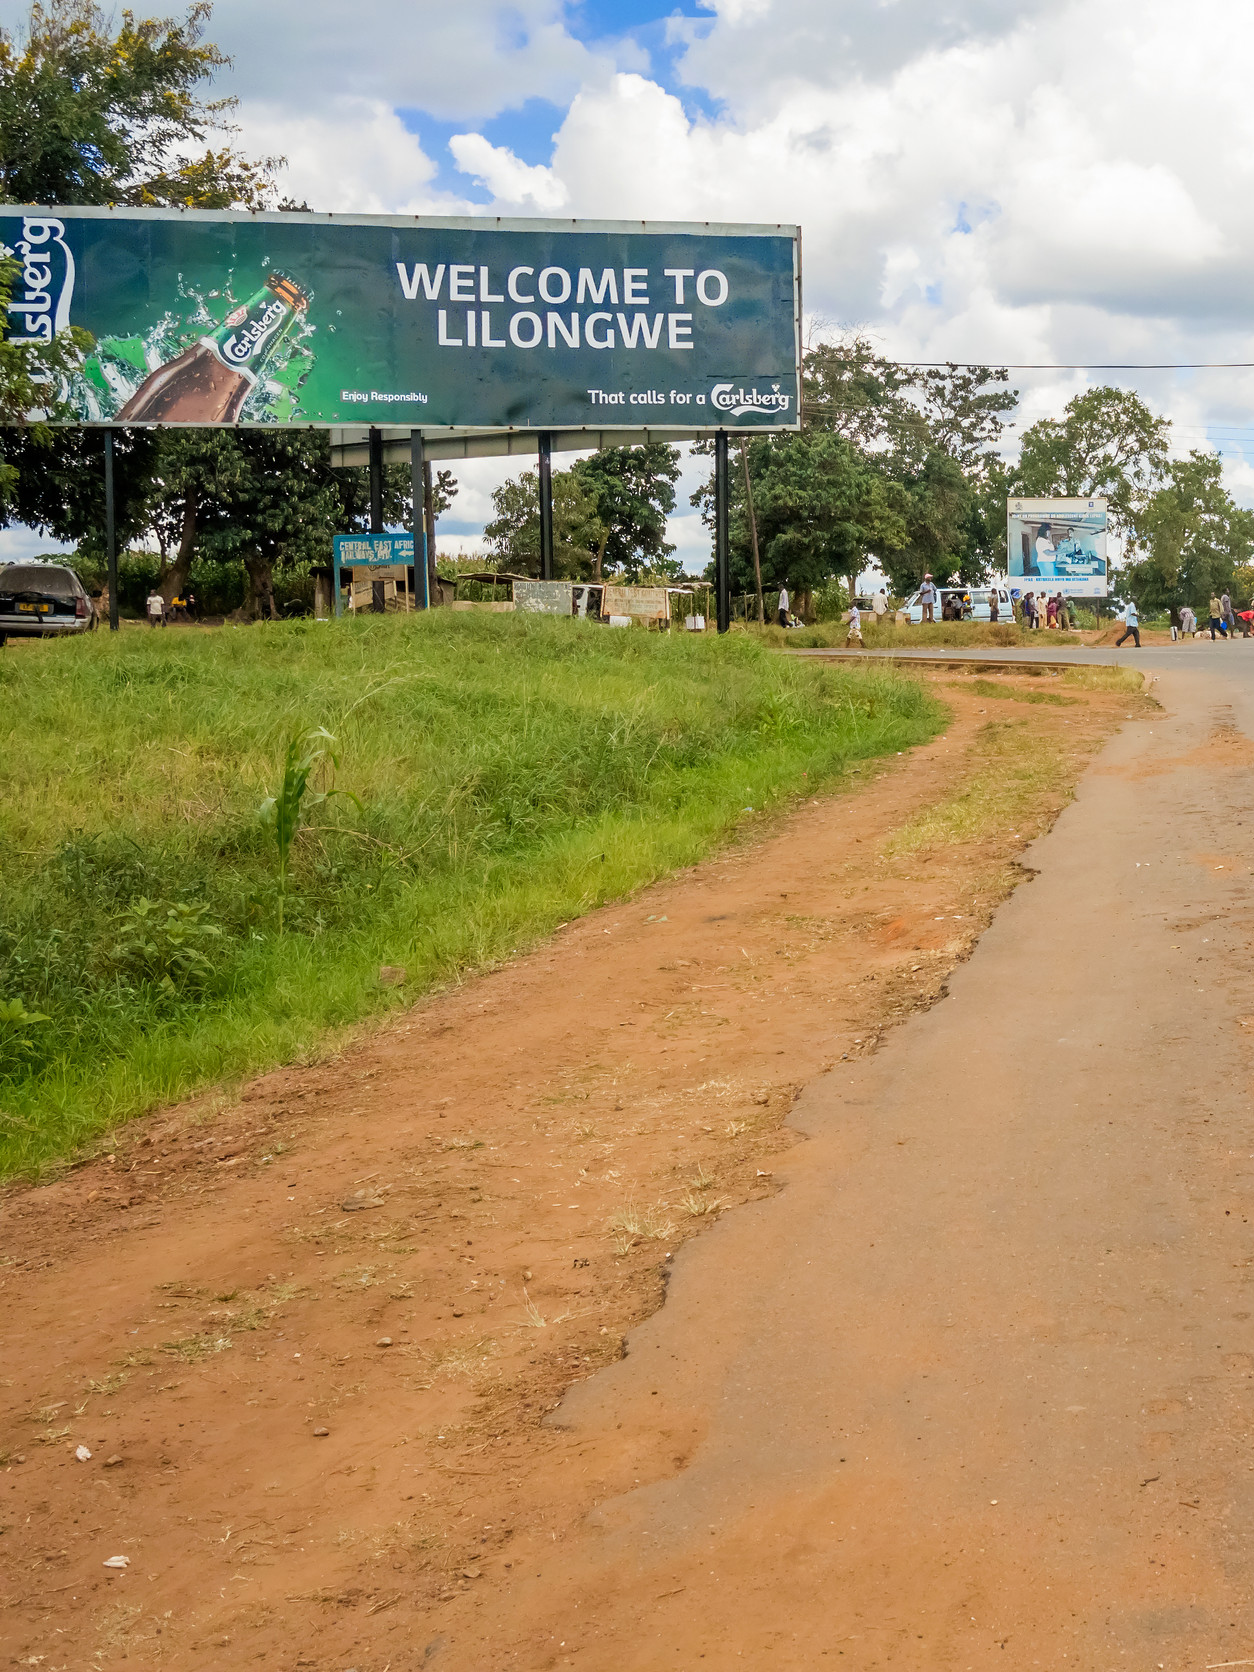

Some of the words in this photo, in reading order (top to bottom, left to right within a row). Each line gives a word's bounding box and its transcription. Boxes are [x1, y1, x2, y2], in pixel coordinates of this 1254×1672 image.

[396, 262, 650, 304] WELCOME
[663, 268, 729, 306] TO
[223, 300, 287, 362] Carlsberg
[438, 309, 694, 348] LILONGWE
[342, 391, 368, 402] Enjoy
[370, 391, 428, 403] Responsibly
[587, 389, 625, 404] That
[629, 390, 665, 404] calls
[669, 390, 692, 404] for
[696, 393, 705, 404] a
[711, 383, 789, 417] Carlsberg
[340, 541, 371, 551] CENTRAL
[374, 540, 392, 551] EAST
[395, 540, 414, 549] AFRIC
